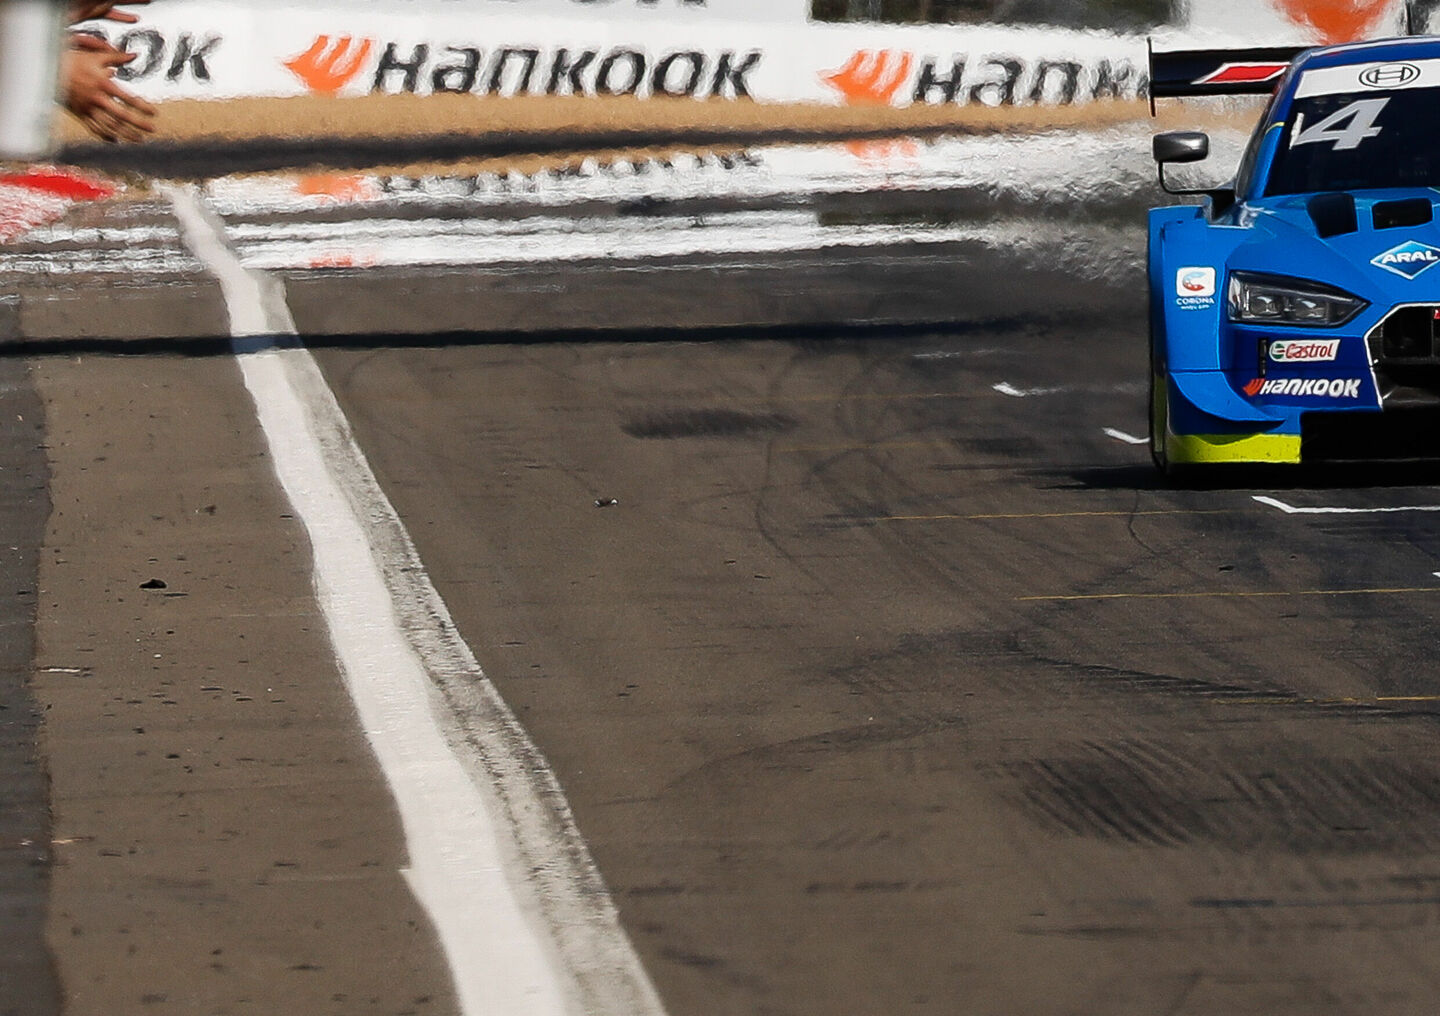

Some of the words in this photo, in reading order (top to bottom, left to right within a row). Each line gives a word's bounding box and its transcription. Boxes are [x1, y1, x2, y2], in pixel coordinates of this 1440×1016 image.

[1292, 97, 1391, 151] 4
[1380, 249, 1440, 265] ARAL
[1285, 342, 1334, 359] Castrol
